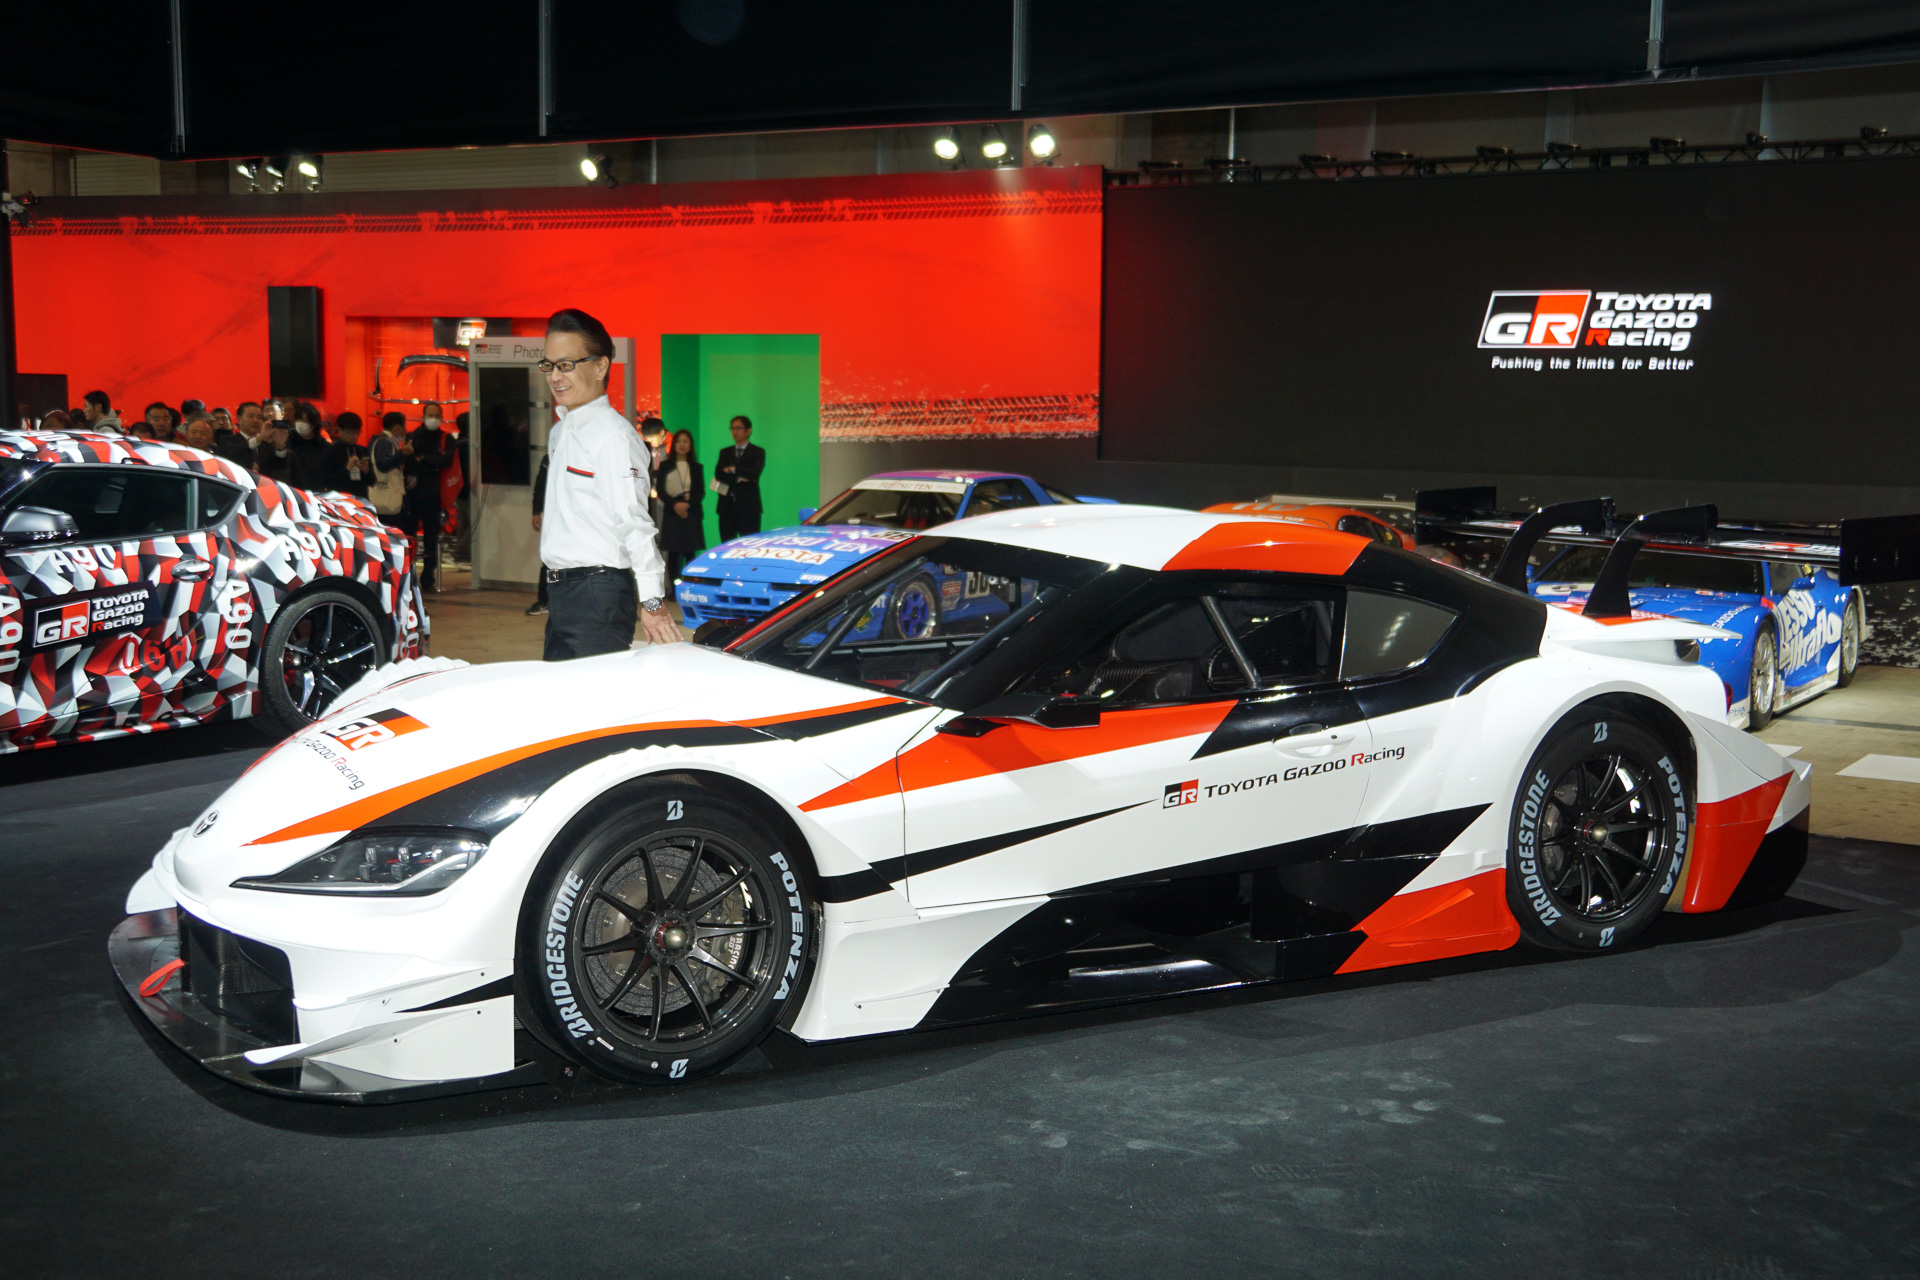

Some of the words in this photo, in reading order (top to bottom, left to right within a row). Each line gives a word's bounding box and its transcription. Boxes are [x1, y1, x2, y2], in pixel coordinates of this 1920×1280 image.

[1595, 291, 1712, 310] TOYOTA
[1484, 312, 1580, 345] GR
[1589, 310, 1698, 329] GAZOO
[1584, 327, 1692, 351] Racing
[1491, 356, 1543, 372] Pushing
[1549, 356, 1571, 370] the
[1576, 356, 1615, 370] limits
[1621, 356, 1643, 370] for
[1648, 356, 1695, 370] Better
[878, 480, 913, 490] FUJITSU
[278, 531, 337, 562] A90
[727, 533, 827, 548] FUJITSU
[822, 539, 877, 554] TEN
[730, 548, 823, 564] TOYOTA
[49, 544, 118, 575] A90
[92, 589, 149, 610] TOYOTA
[92, 602, 145, 622] GAZOO
[37, 615, 88, 644] GR
[91, 614, 144, 633] Racing
[224, 580, 252, 650] A90
[326, 717, 396, 750] GR
[330, 757, 365, 791] Racing
[1164, 788, 1198, 807] GR
[1205, 773, 1278, 798] TOYOTA
[1283, 758, 1347, 781] GAZOO
[1350, 746, 1405, 767] Racing
[1657, 756, 1689, 895] POTENZA
[1518, 769, 1562, 926] BRIDGESTONE
[769, 851, 804, 1000] POTENZA
[546, 870, 595, 1039] BRIDGESTONE
